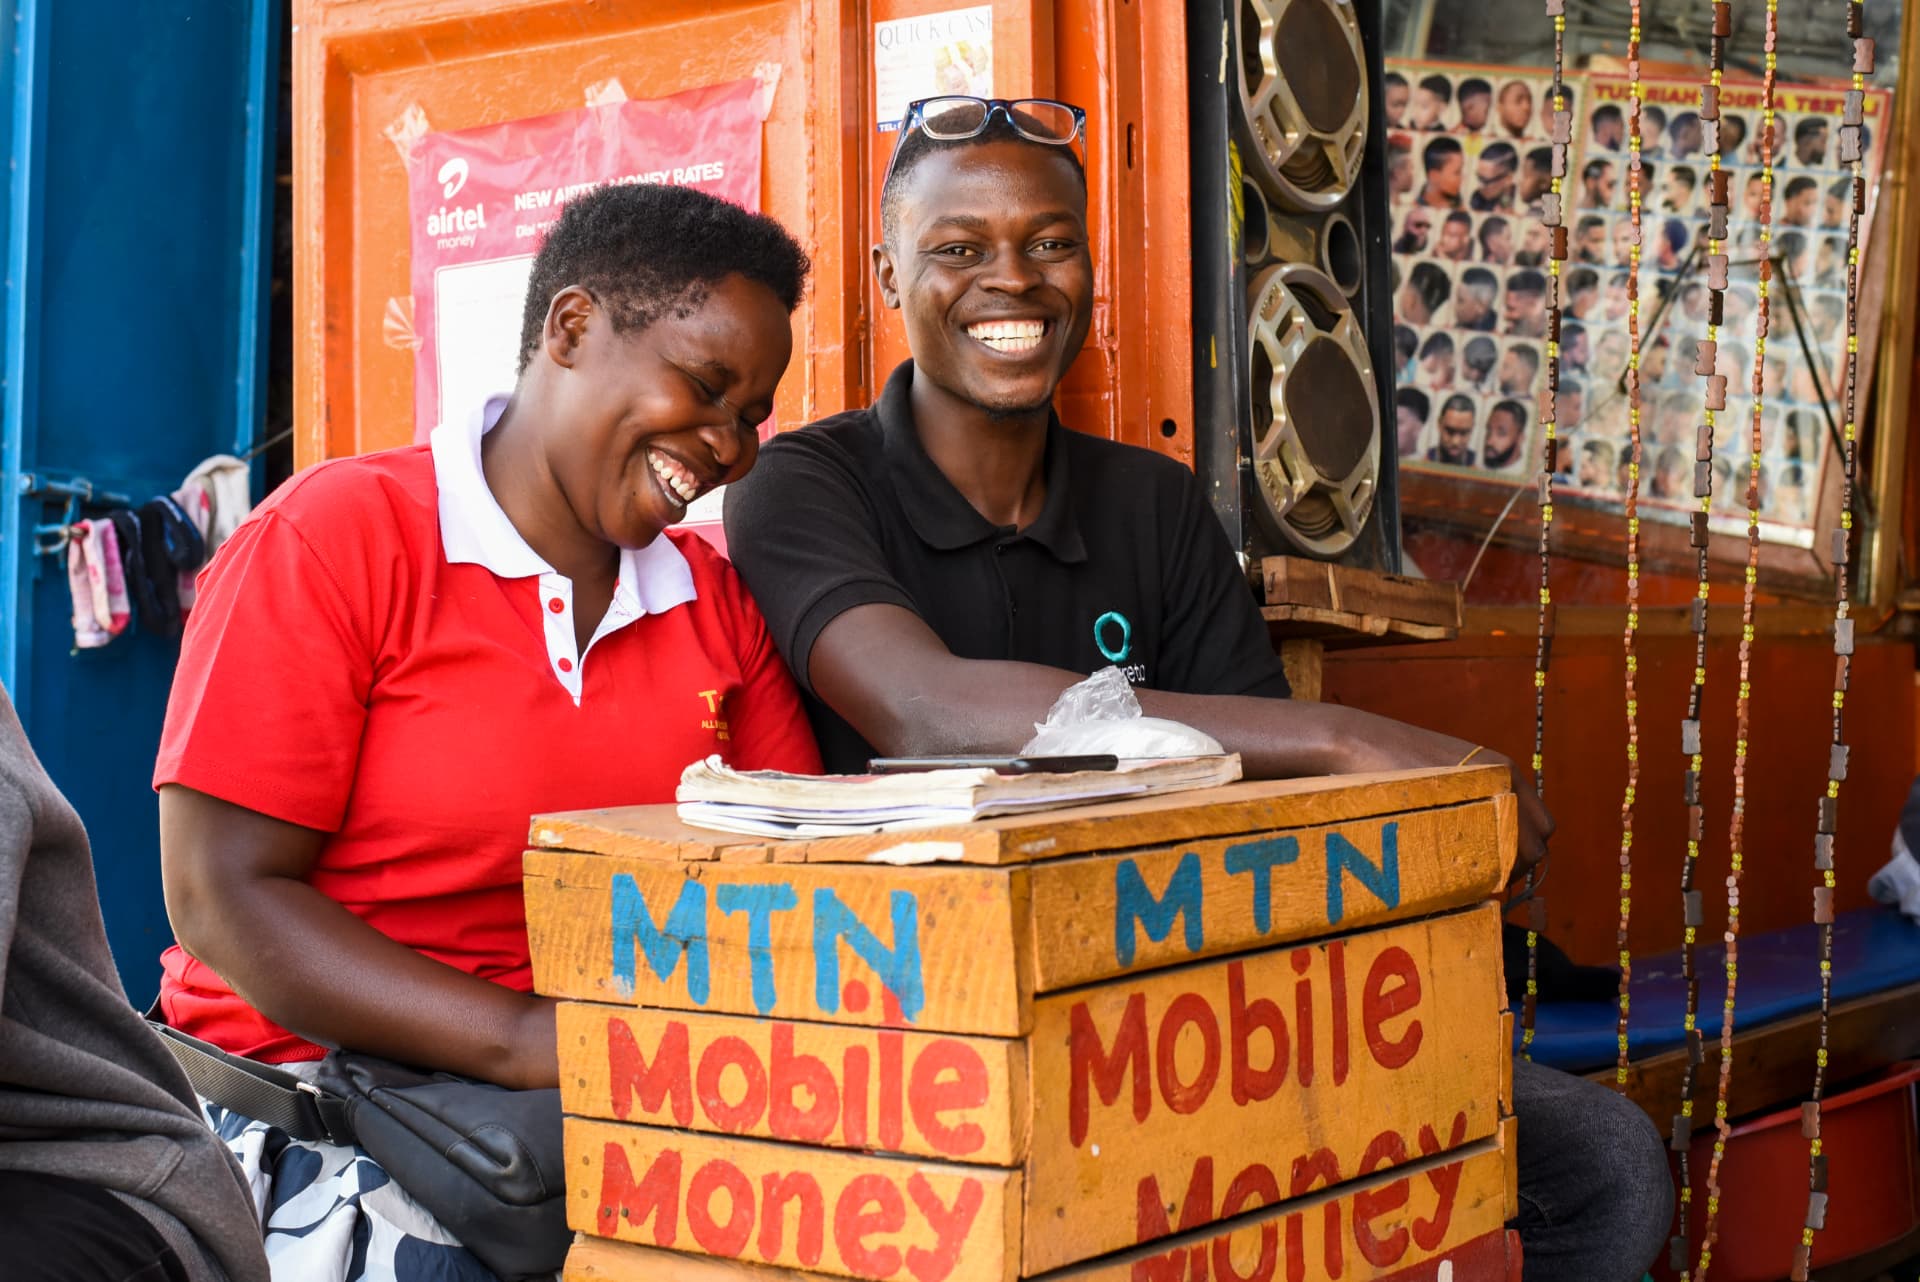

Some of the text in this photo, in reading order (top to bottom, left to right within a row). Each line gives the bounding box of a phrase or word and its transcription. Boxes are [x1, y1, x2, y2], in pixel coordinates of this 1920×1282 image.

[427, 202, 486, 236] airtel
[437, 233, 477, 250] money
[514, 188, 552, 211] NEW
[672, 161, 724, 185] RATES
[611, 873, 925, 1024] MTN
[1115, 821, 1400, 967] MTN
[607, 979, 989, 1156] Mobile
[1069, 940, 1424, 1149] Mobile
[597, 1141, 985, 1282] Money
[1130, 1112, 1467, 1282] Money
